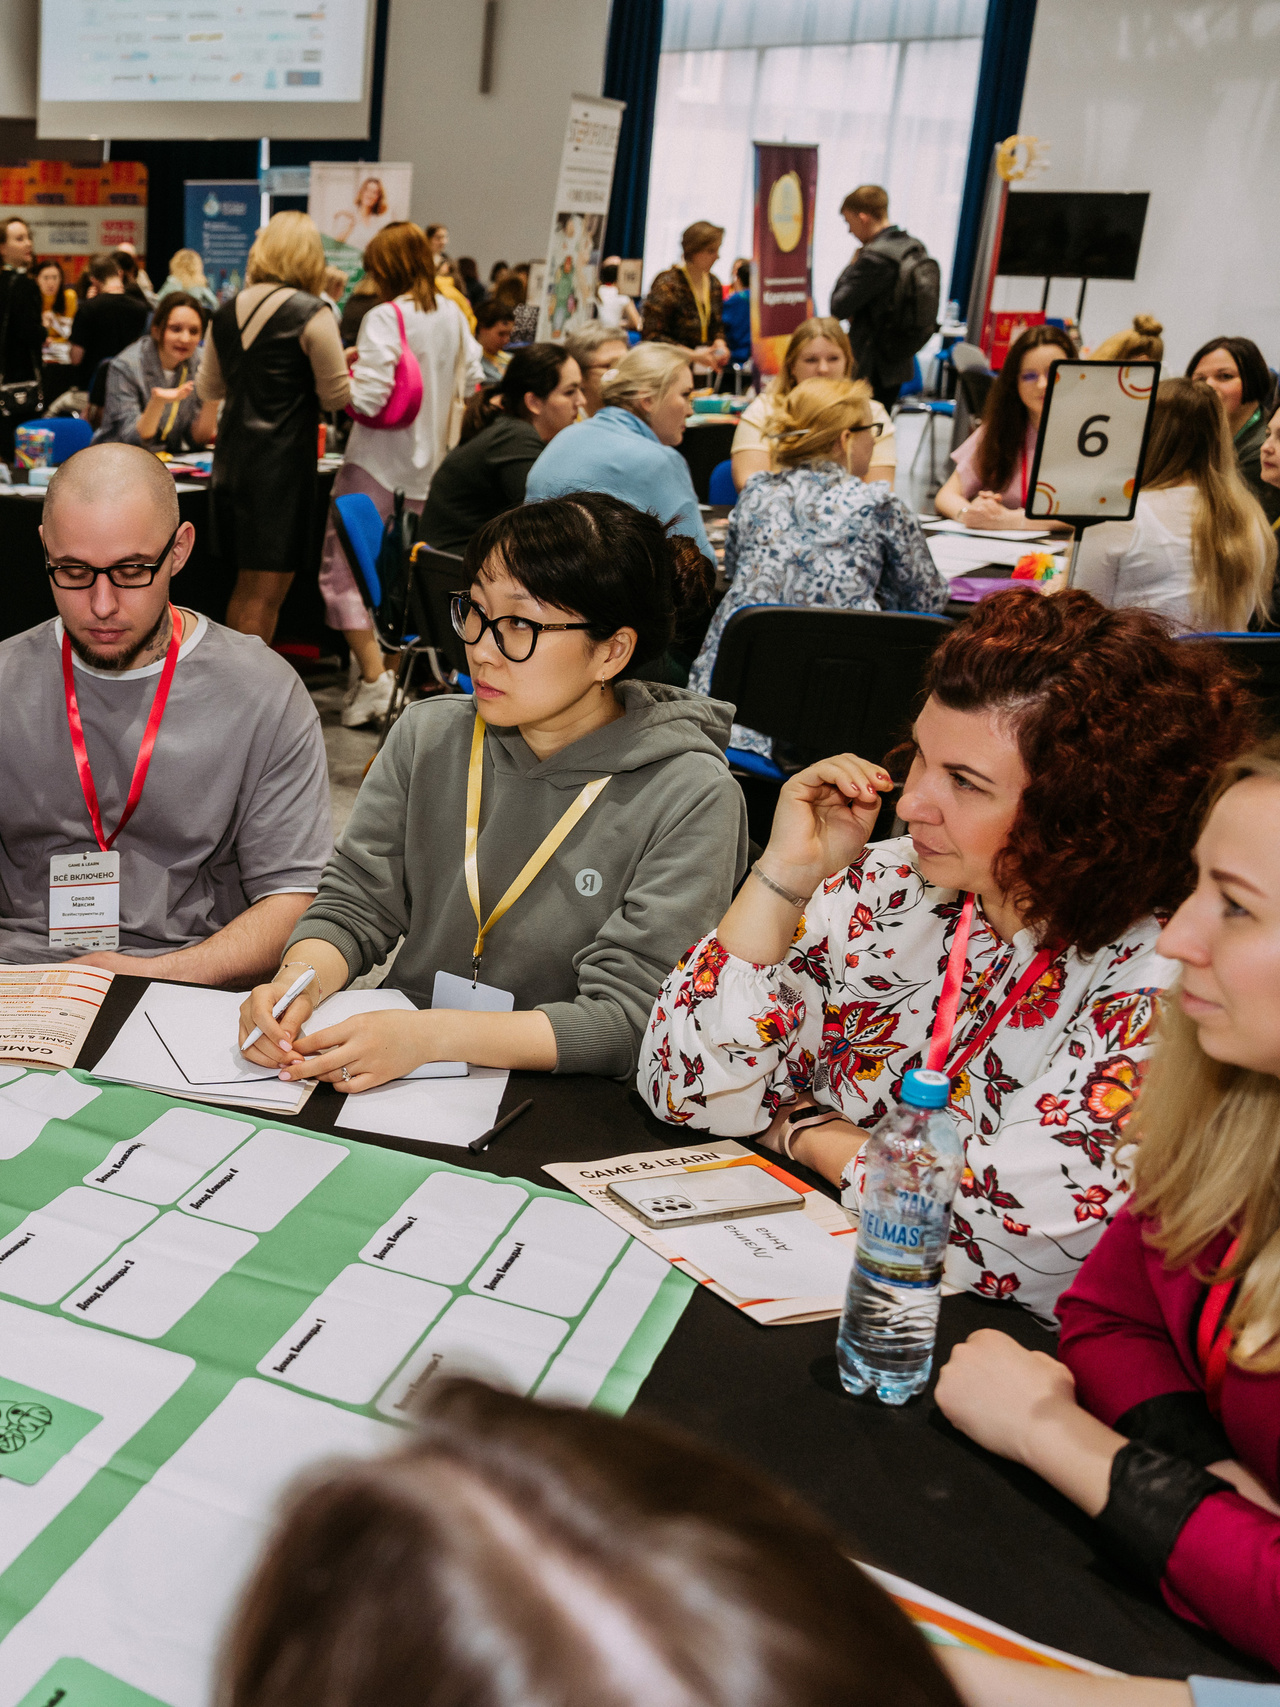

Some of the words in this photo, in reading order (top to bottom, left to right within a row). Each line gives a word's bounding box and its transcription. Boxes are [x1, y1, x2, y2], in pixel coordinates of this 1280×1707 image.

[1076, 414, 1111, 458] 6
[53, 873, 69, 882] ВСЁ
[70, 871, 115, 881] ВКЛЮЧЕНО
[37, 1035, 73, 1046] GAME
[579, 1164, 638, 1179] GAME
[639, 1161, 656, 1170] &
[655, 1151, 721, 1168] LEARN
[723, 1224, 773, 1259] Лузина
[755, 1227, 793, 1251] Анна
[864, 1209, 920, 1247] TELMAS
